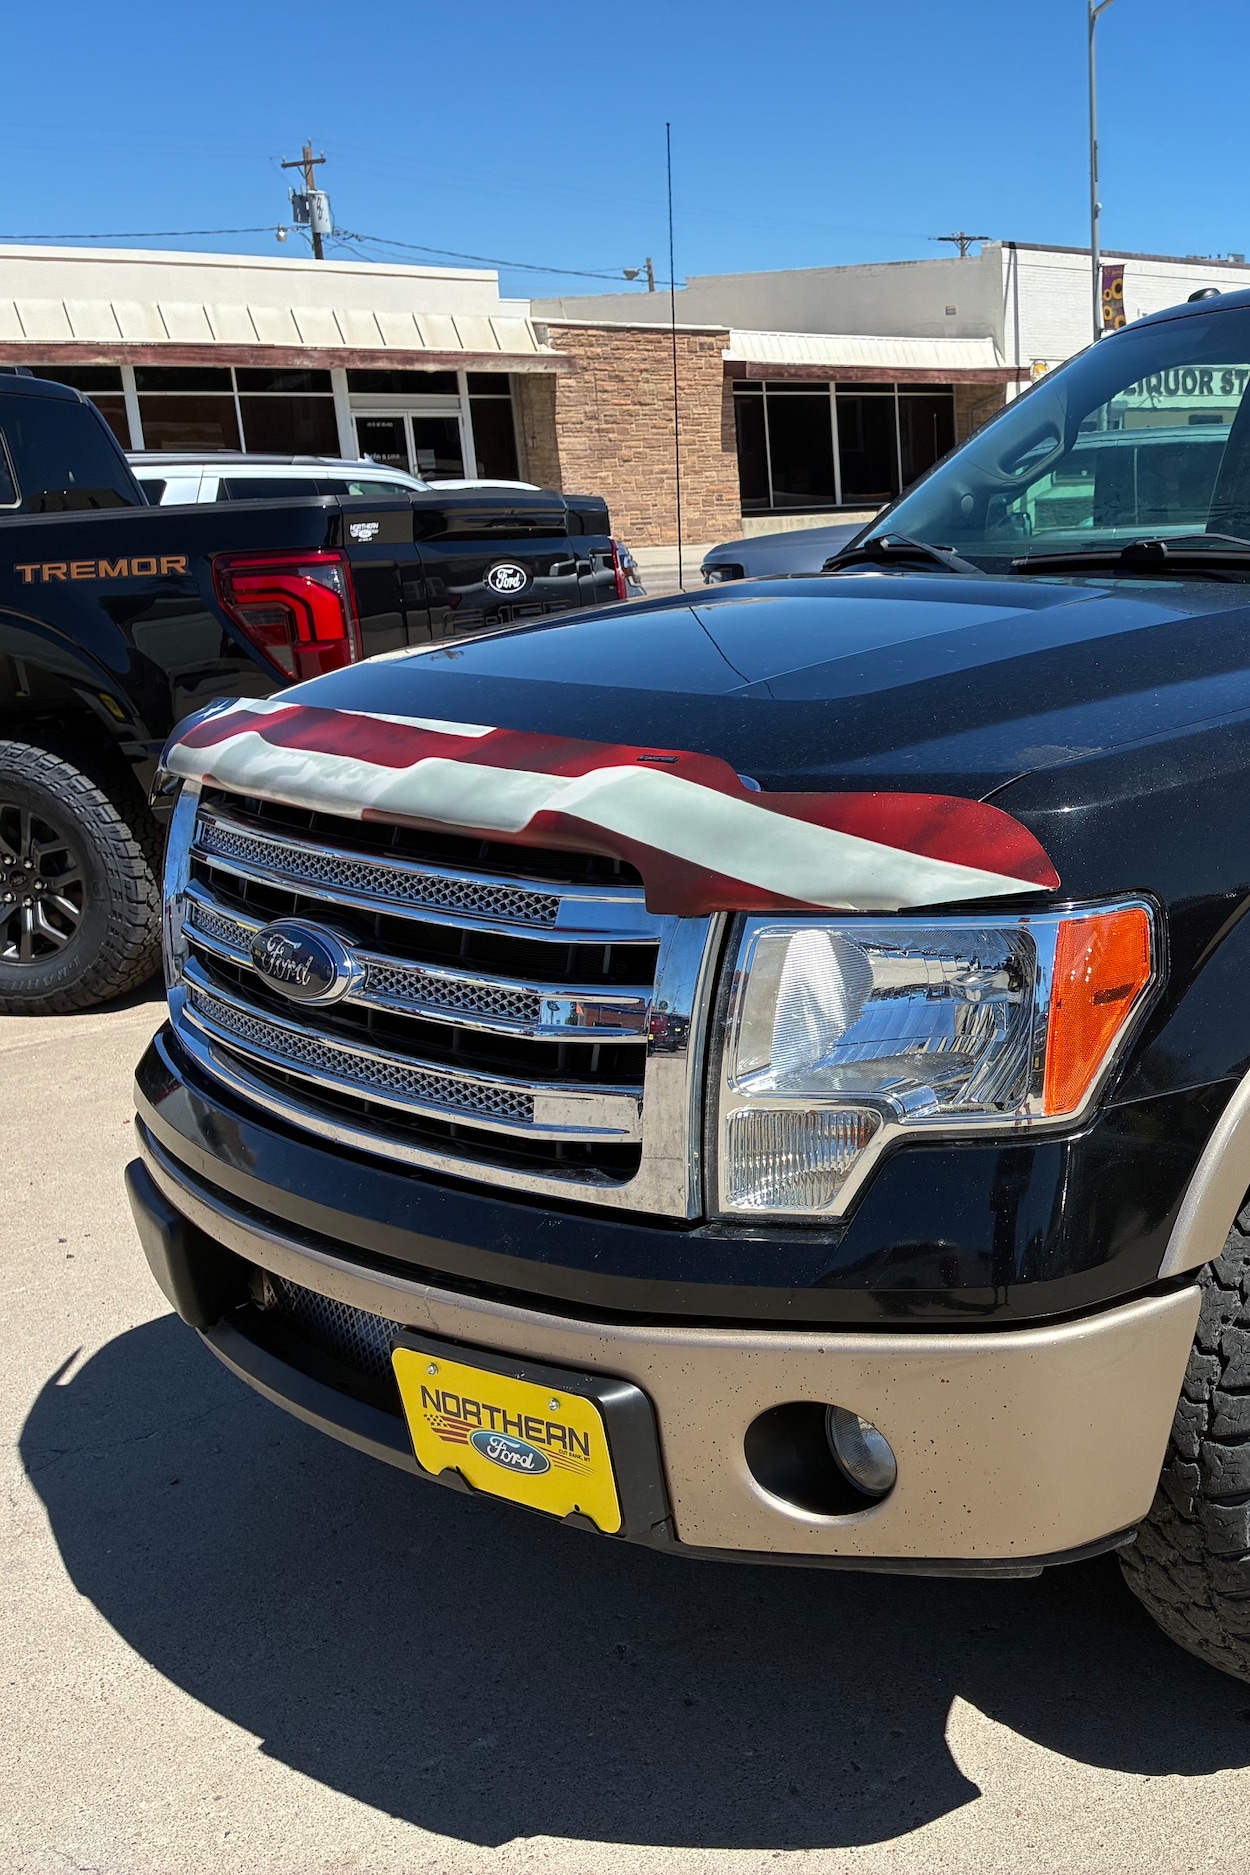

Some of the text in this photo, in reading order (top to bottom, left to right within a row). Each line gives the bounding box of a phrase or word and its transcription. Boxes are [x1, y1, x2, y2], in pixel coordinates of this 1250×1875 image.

[14, 554, 190, 583] TREMOR
[495, 568, 521, 589] Ford
[261, 933, 315, 986] Ford
[420, 1385, 591, 1457] NORTHERN
[486, 1435, 534, 1470] Ford
